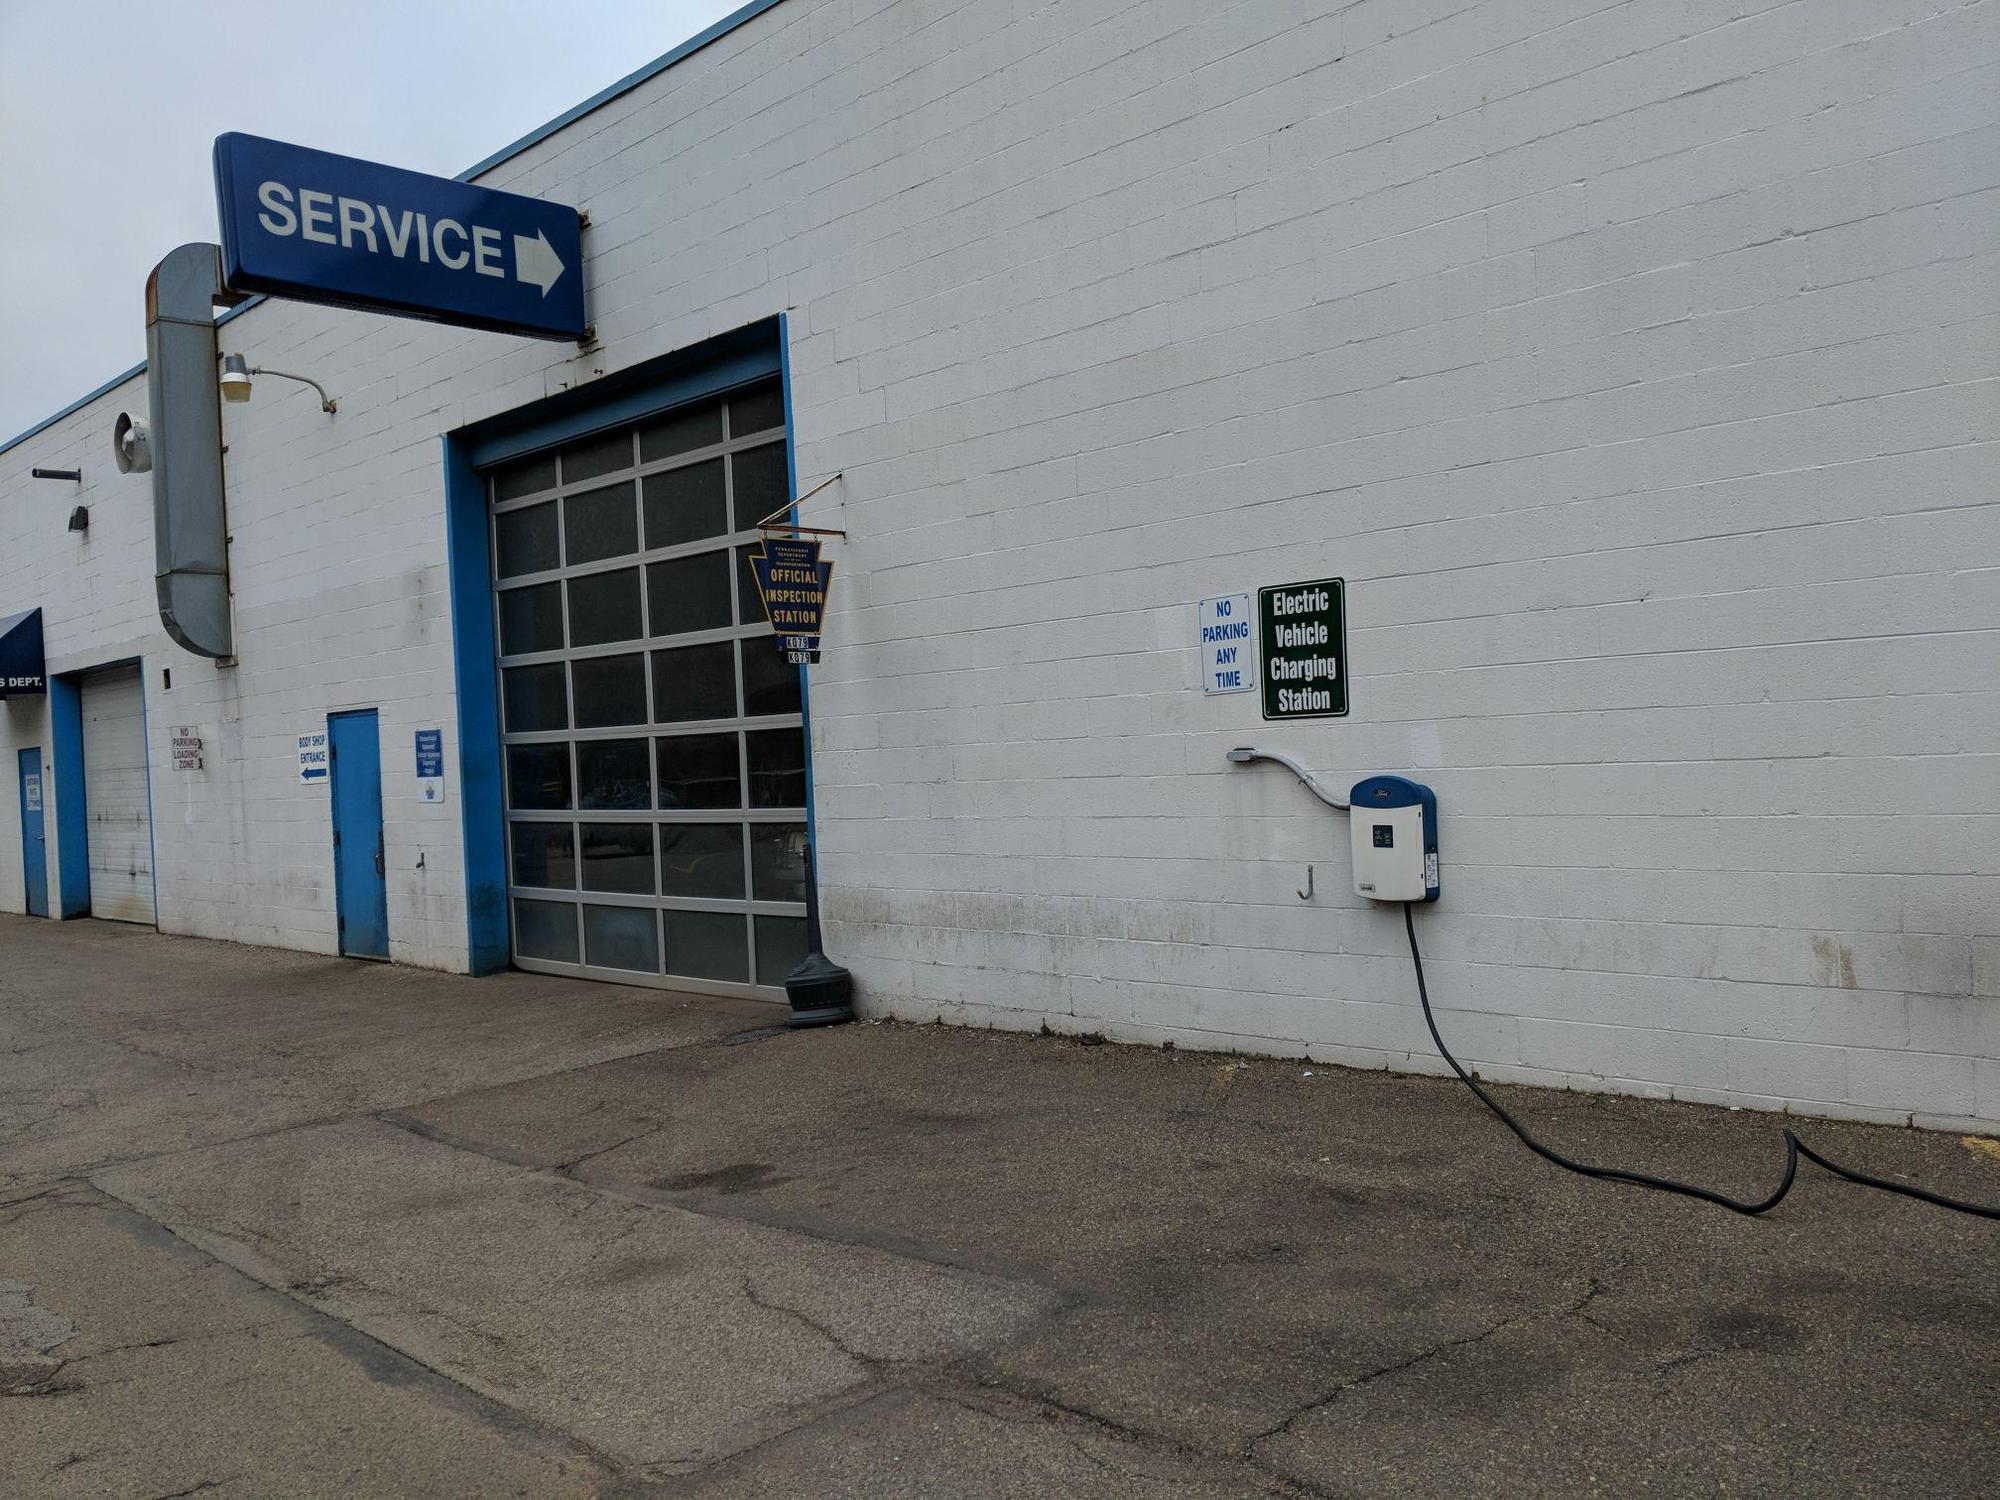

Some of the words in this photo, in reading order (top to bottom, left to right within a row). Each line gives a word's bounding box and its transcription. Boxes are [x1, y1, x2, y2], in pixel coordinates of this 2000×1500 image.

[258, 181, 505, 278] SERVICE
[770, 568, 818, 584] OFFICIAL
[766, 589, 823, 604] INSPECTION
[1273, 588, 1329, 616] Electric
[774, 609, 817, 624] STATION
[1216, 600, 1232, 618] NO
[1202, 621, 1249, 643] PARKING
[1275, 621, 1328, 648] Vehicle
[1216, 647, 1237, 665] ANY
[1270, 654, 1337, 681] Charging
[9, 677, 42, 687] DEPT.
[1215, 670, 1241, 688] TIME
[1278, 687, 1331, 712] Station
[180, 728, 189, 737] NO
[173, 738, 198, 747] PARKING
[299, 736, 311, 748] BODY
[312, 734, 325, 747] SHOP
[174, 750, 199, 759] LOADING
[300, 751, 326, 764] ENTRANCE
[179, 760, 194, 769] ZONE
